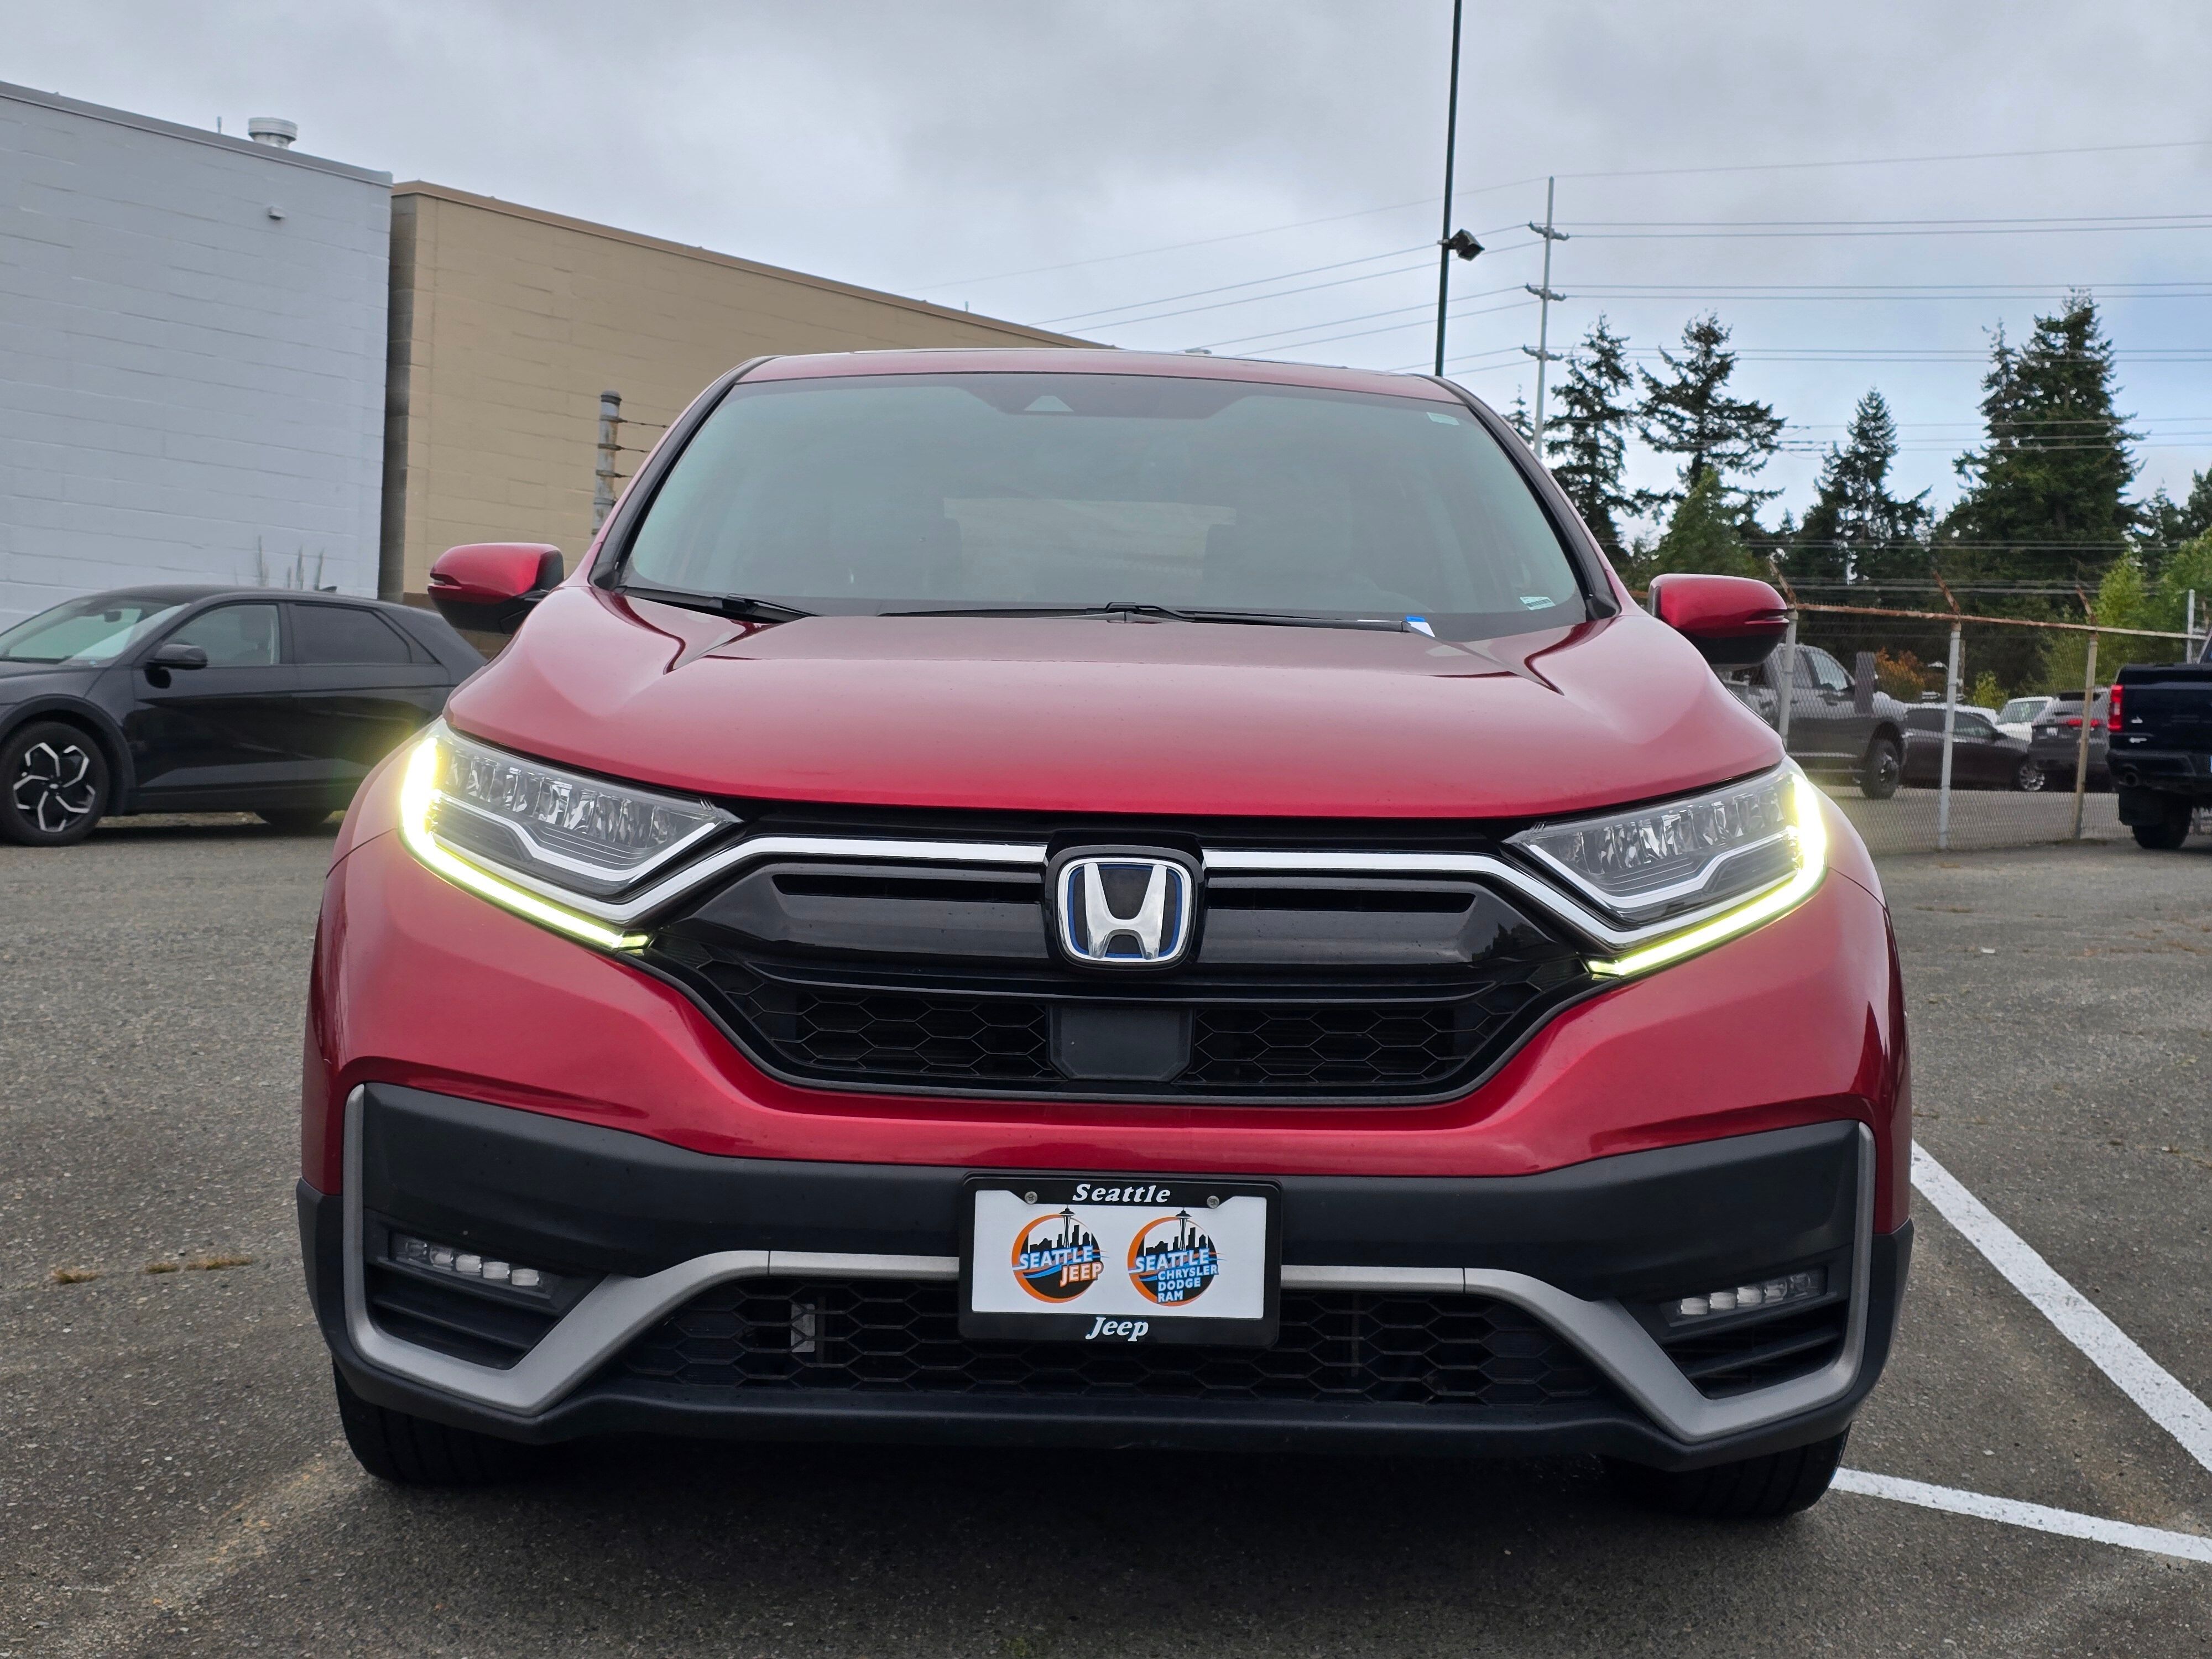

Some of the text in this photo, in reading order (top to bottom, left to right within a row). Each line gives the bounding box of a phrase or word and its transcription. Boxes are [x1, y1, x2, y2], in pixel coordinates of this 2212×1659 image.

[1072, 1183, 1170, 1203] Seattle
[1019, 1245, 1094, 1270] SEATTLE
[1135, 1248, 1209, 1272] SEATTLE
[1060, 1261, 1103, 1288] JEEP
[1157, 1264, 1219, 1282] CHRYSLER
[1158, 1277, 1201, 1292] DODGE
[1157, 1290, 1184, 1302] RAM
[1086, 1317, 1149, 1342] Jeep
